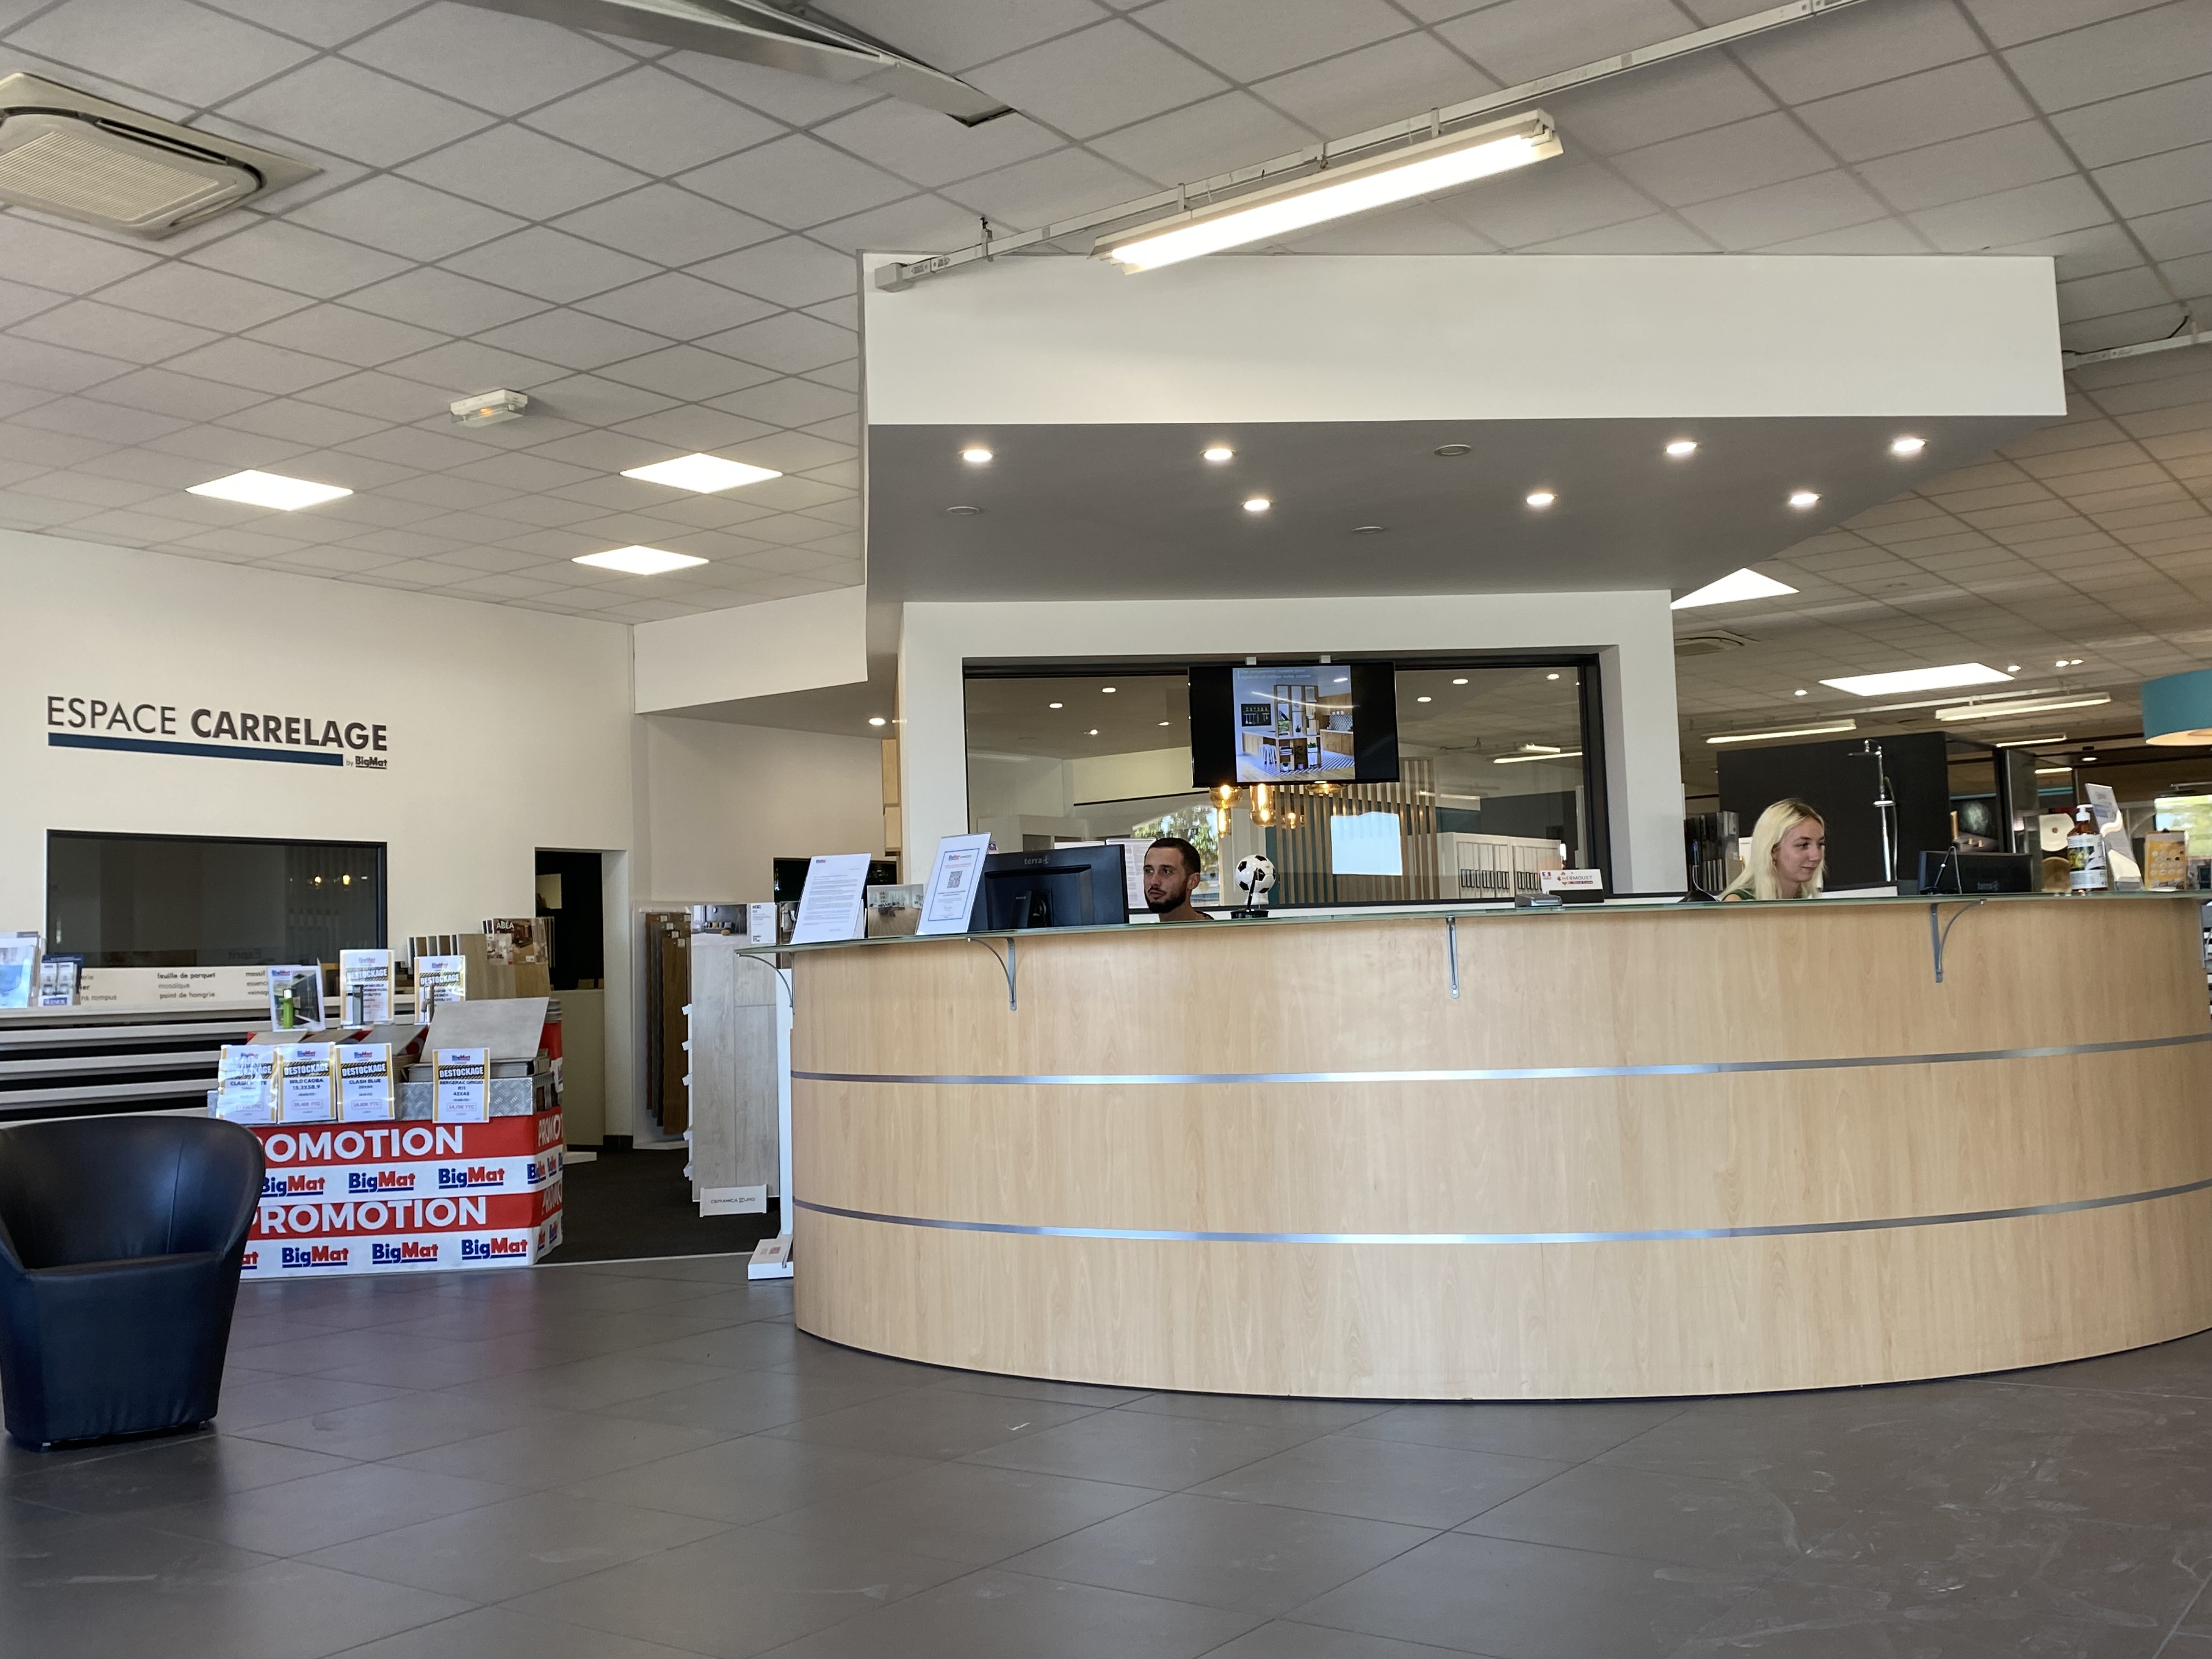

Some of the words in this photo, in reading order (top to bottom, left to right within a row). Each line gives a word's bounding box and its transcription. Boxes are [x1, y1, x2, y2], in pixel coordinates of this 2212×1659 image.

[47, 696, 176, 735] ESPACE
[191, 708, 387, 752] CARRELAGE
[346, 759, 353, 768] by
[355, 755, 387, 769] BigMat
[190, 972, 216, 980] parquet
[346, 969, 387, 980] DESTOCKAGE
[420, 974, 460, 985] DESTOCKAGE
[188, 991, 215, 1000] hongrie
[284, 1063, 329, 1076] DESTOCKAGE
[342, 1063, 386, 1077] DESTOCKAGE
[439, 1066, 484, 1078] DESTOCKAGE
[259, 1125, 463, 1162] OMOTION
[348, 1170, 415, 1194] BigMat
[438, 1166, 505, 1189] BigMat
[281, 1245, 349, 1268] BigMat
[372, 1242, 439, 1265] BigMat
[461, 1238, 528, 1261] BigMat
